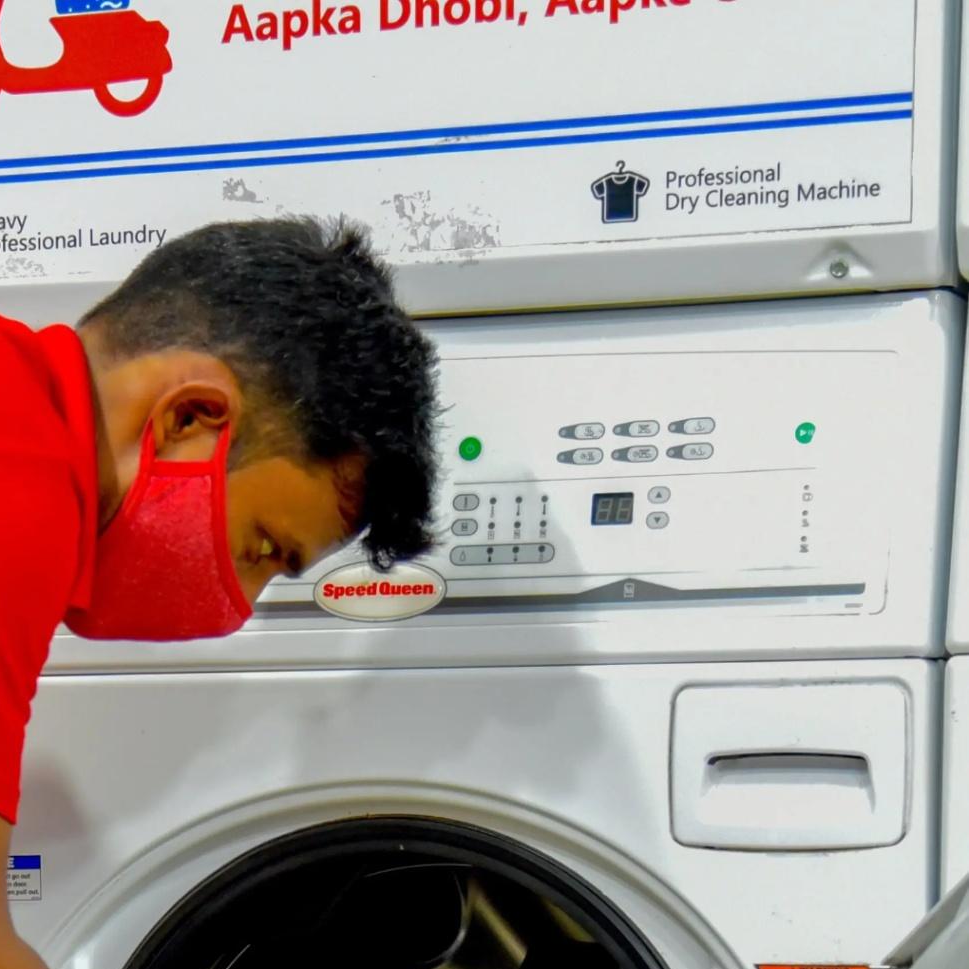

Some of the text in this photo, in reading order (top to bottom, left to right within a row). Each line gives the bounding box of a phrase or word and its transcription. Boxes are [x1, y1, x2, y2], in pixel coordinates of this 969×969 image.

[221, 0, 362, 50] Aapka
[379, 0, 528, 31] Dhobi,
[665, 162, 781, 188] Professional
[665, 179, 881, 214] Dry Cleaning Machine
[89, 224, 167, 247] Laundry
[323, 583, 377, 599] Speed
